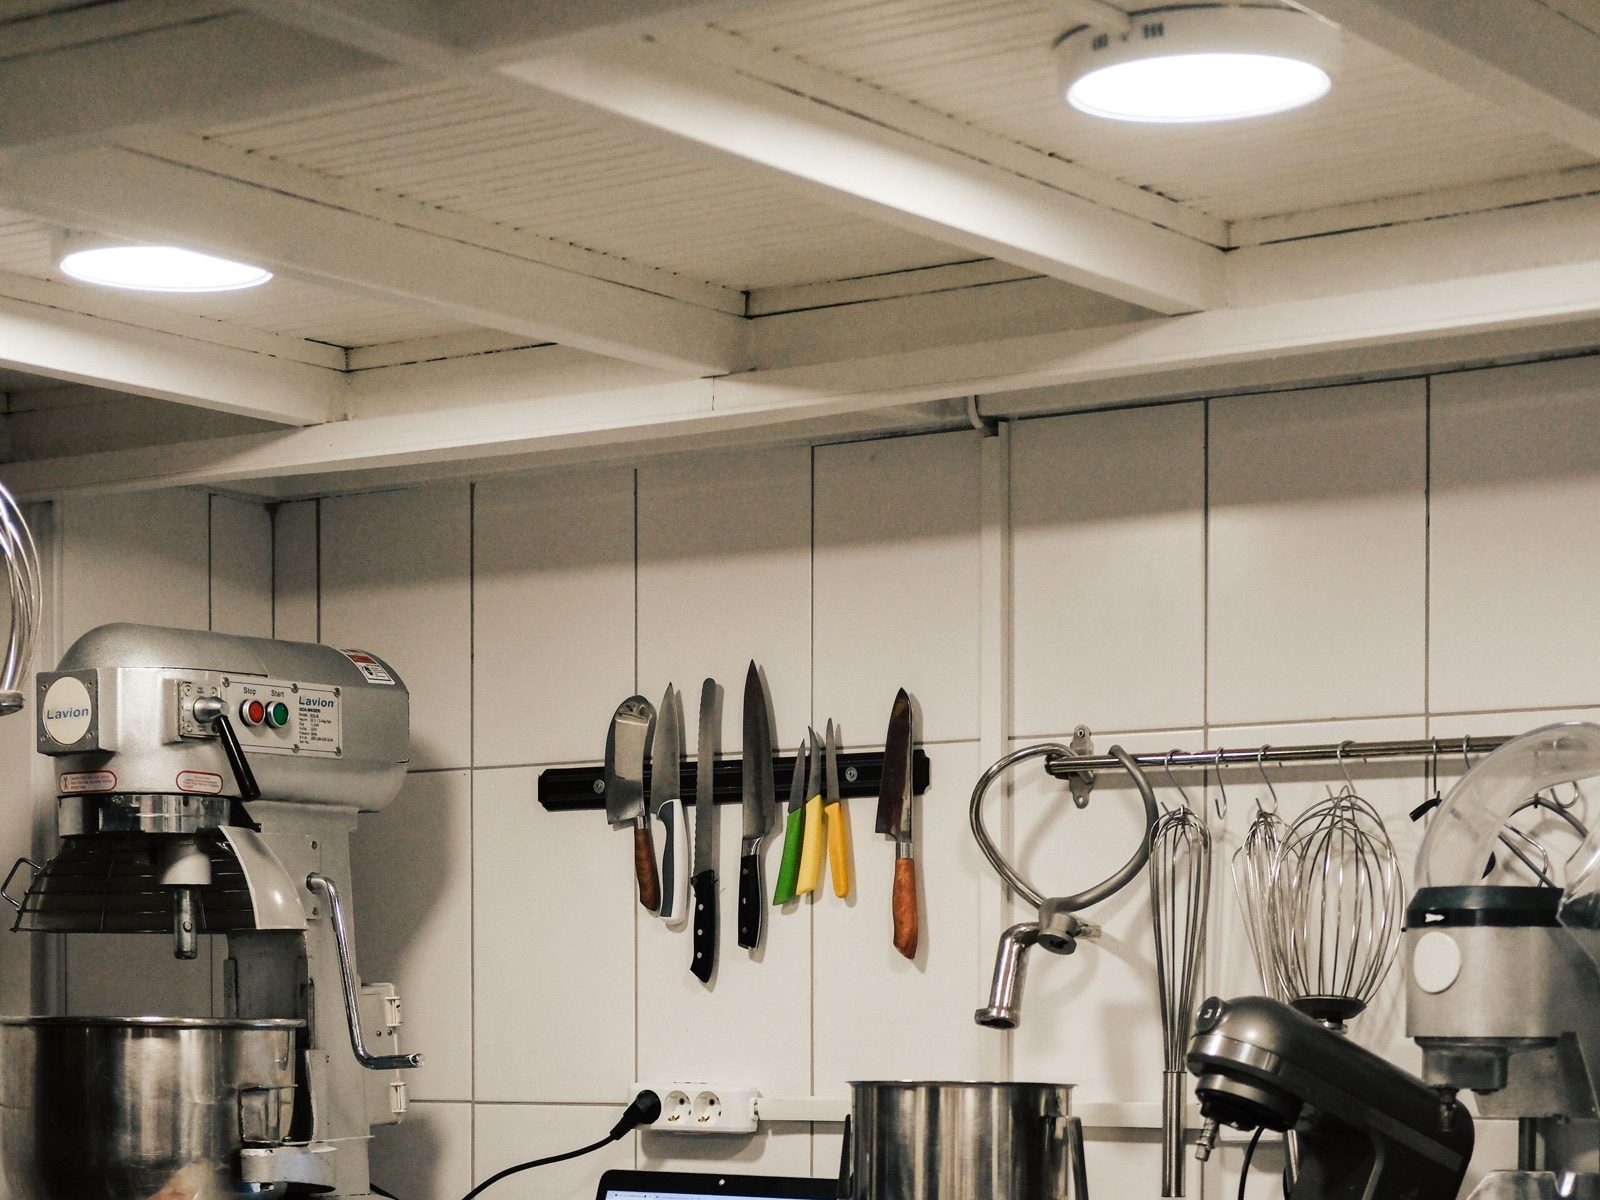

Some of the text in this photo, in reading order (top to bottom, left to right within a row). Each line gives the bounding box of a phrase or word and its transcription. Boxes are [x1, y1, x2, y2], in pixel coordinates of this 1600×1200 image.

[243, 686, 257, 695] Stop
[271, 689, 285, 698] Start
[298, 695, 334, 708] Lavion
[47, 708, 89, 720] Lavion
